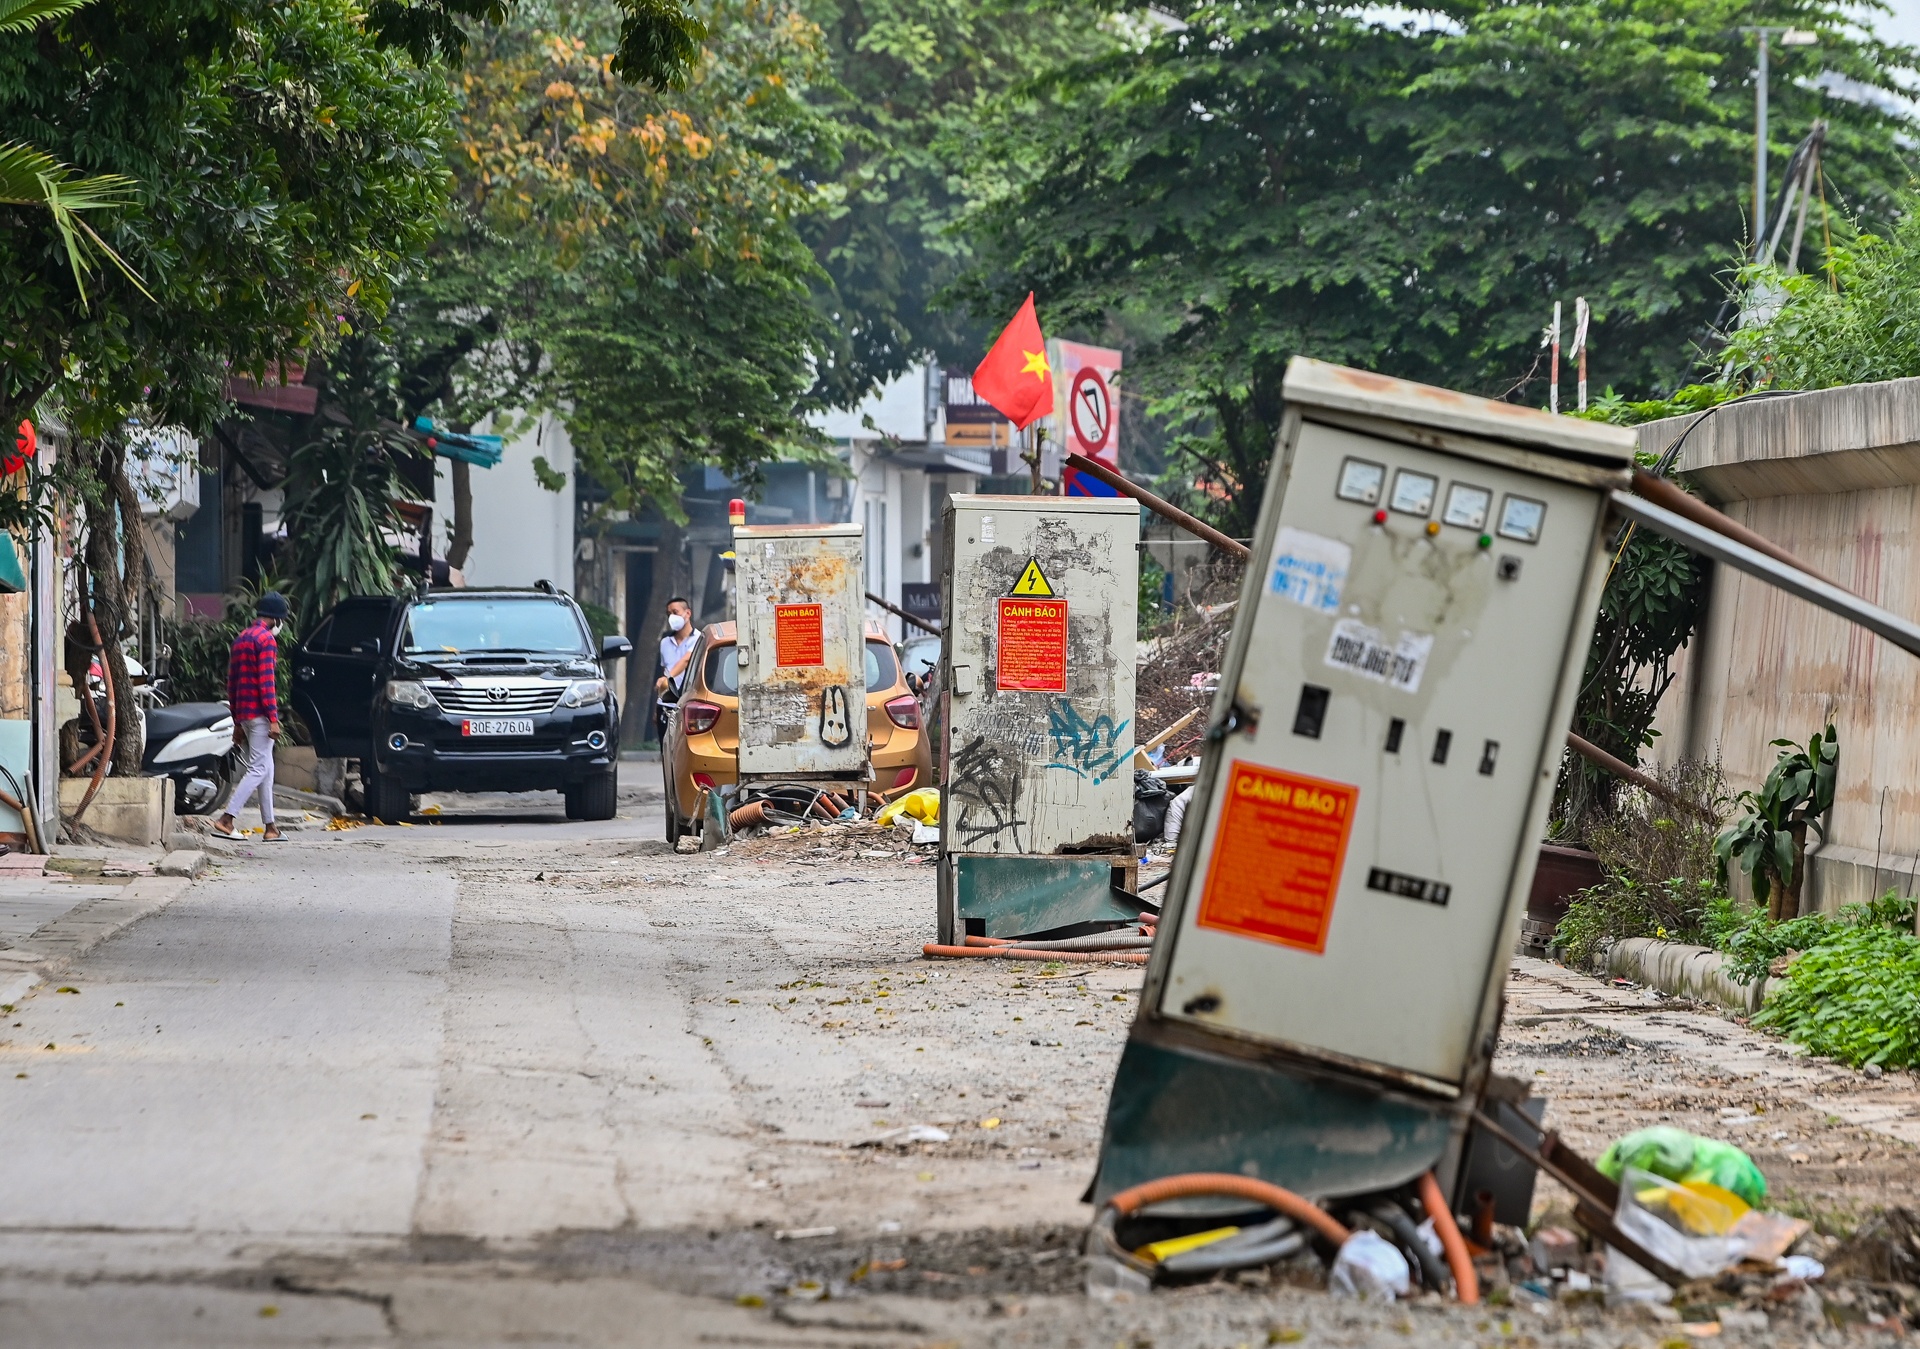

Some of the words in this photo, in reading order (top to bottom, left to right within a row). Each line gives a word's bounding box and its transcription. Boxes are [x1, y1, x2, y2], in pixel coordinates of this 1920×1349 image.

[778, 608, 799, 617] CẢNH
[799, 607, 815, 617] BÁO
[1003, 604, 1032, 617] CẢNH
[1034, 605, 1057, 618] BÁO
[1236, 775, 1292, 805] CẢNH
[1292, 786, 1336, 816] BÁO
